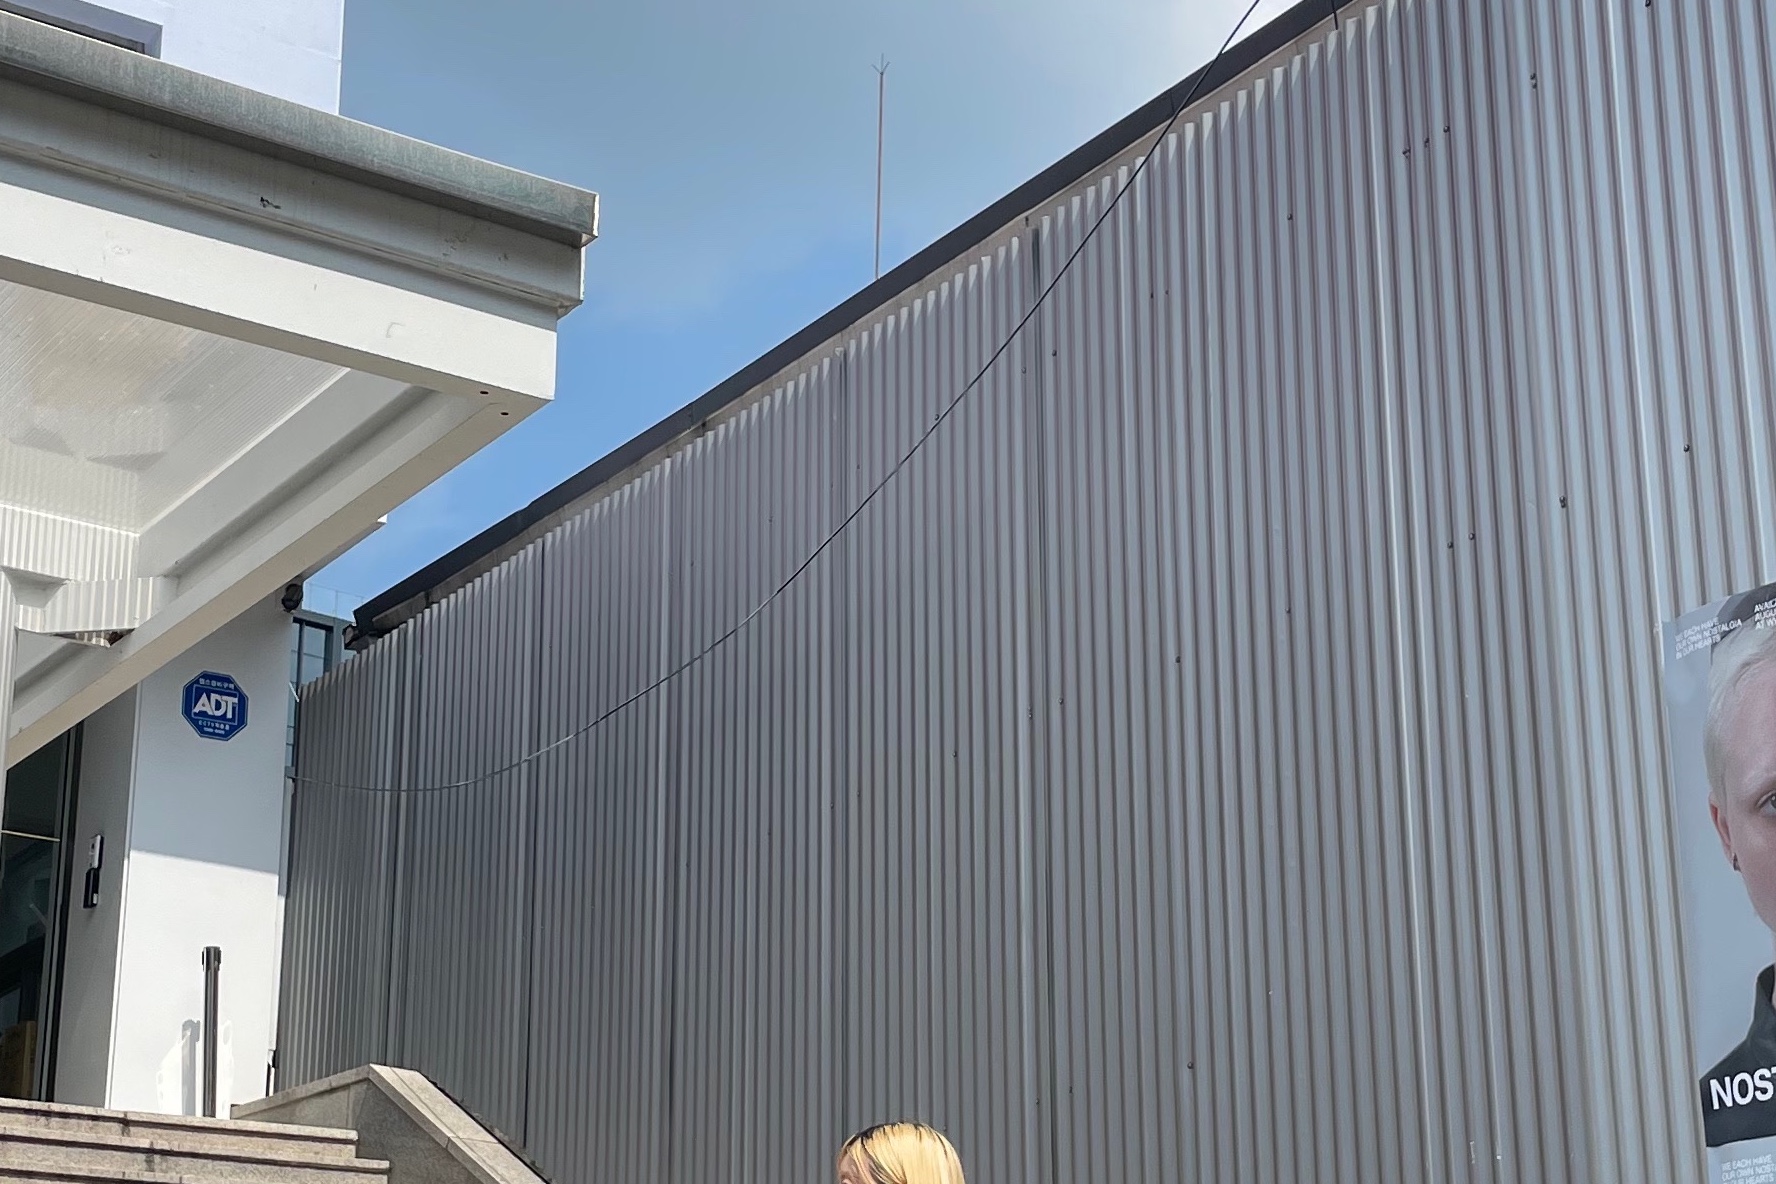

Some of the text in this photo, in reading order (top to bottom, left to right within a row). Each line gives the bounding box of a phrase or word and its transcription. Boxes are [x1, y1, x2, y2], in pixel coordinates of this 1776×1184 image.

[1703, 618, 1743, 637] NOSTALGIA
[192, 691, 239, 719] ADT
[1755, 1163, 1776, 1174] NOST
